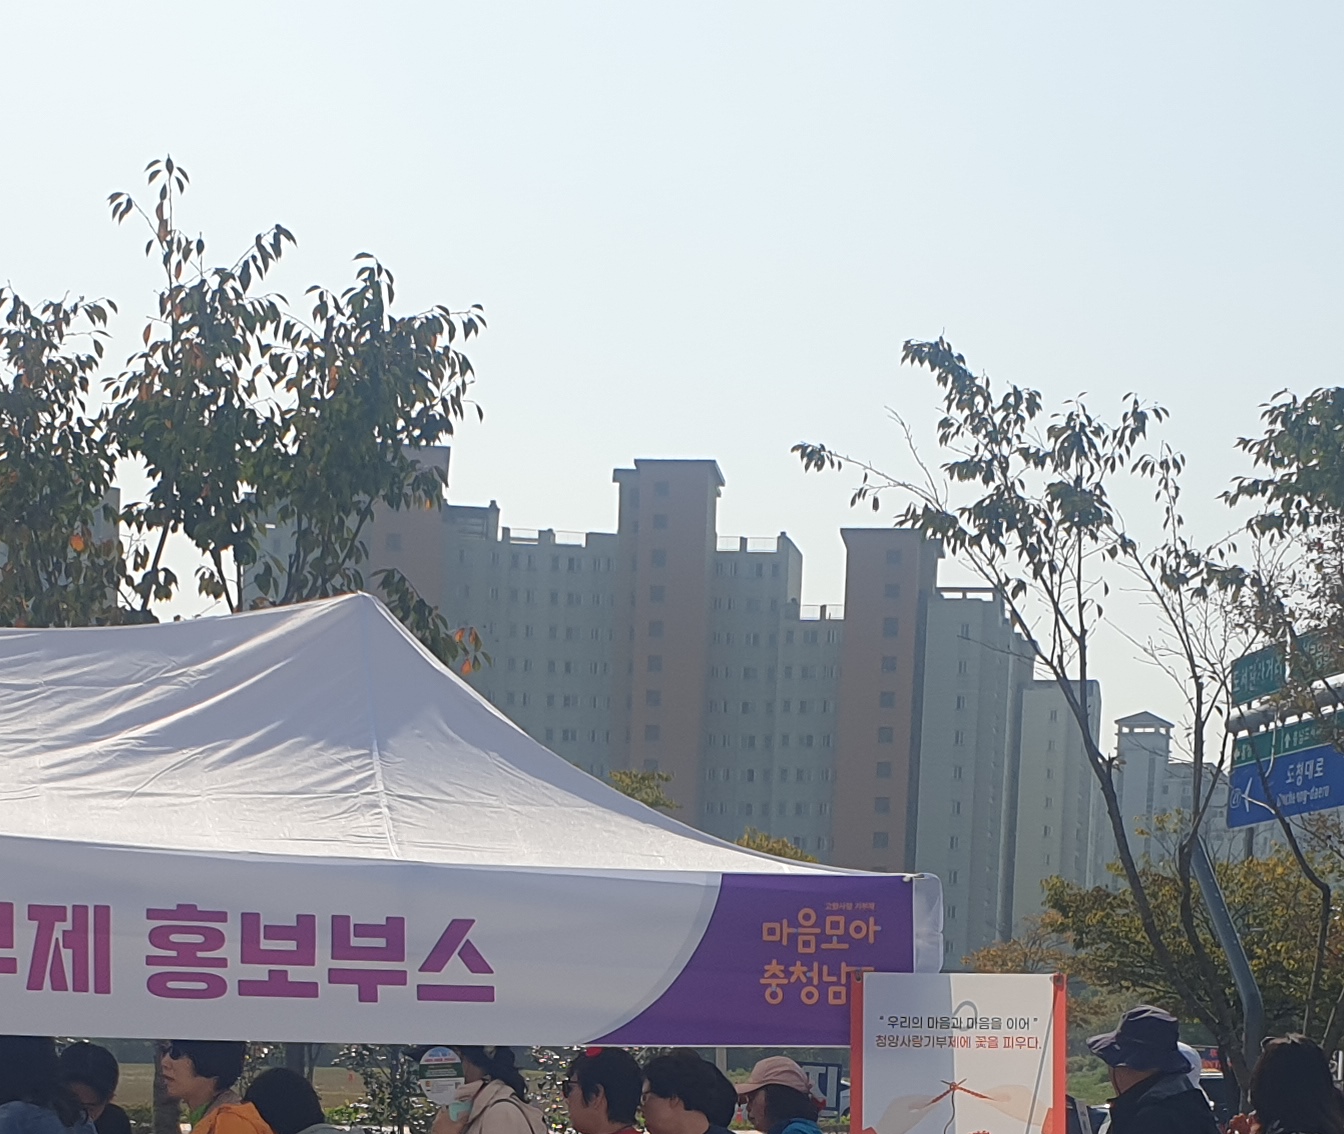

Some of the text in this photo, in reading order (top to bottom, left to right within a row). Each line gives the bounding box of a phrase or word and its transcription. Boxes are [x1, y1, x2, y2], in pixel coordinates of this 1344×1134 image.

[1285, 757, 1325, 787] 도청대로
[761, 907, 882, 954] 마음모아
[144, 902, 498, 1006] 홍보부스
[759, 958, 875, 1006] 충청남
[927, 1015, 963, 1030] 마음과
[966, 1015, 1003, 1031] 마음을
[875, 1035, 1042, 1050] 청양사랑기부제에 꽃을 피우다.
